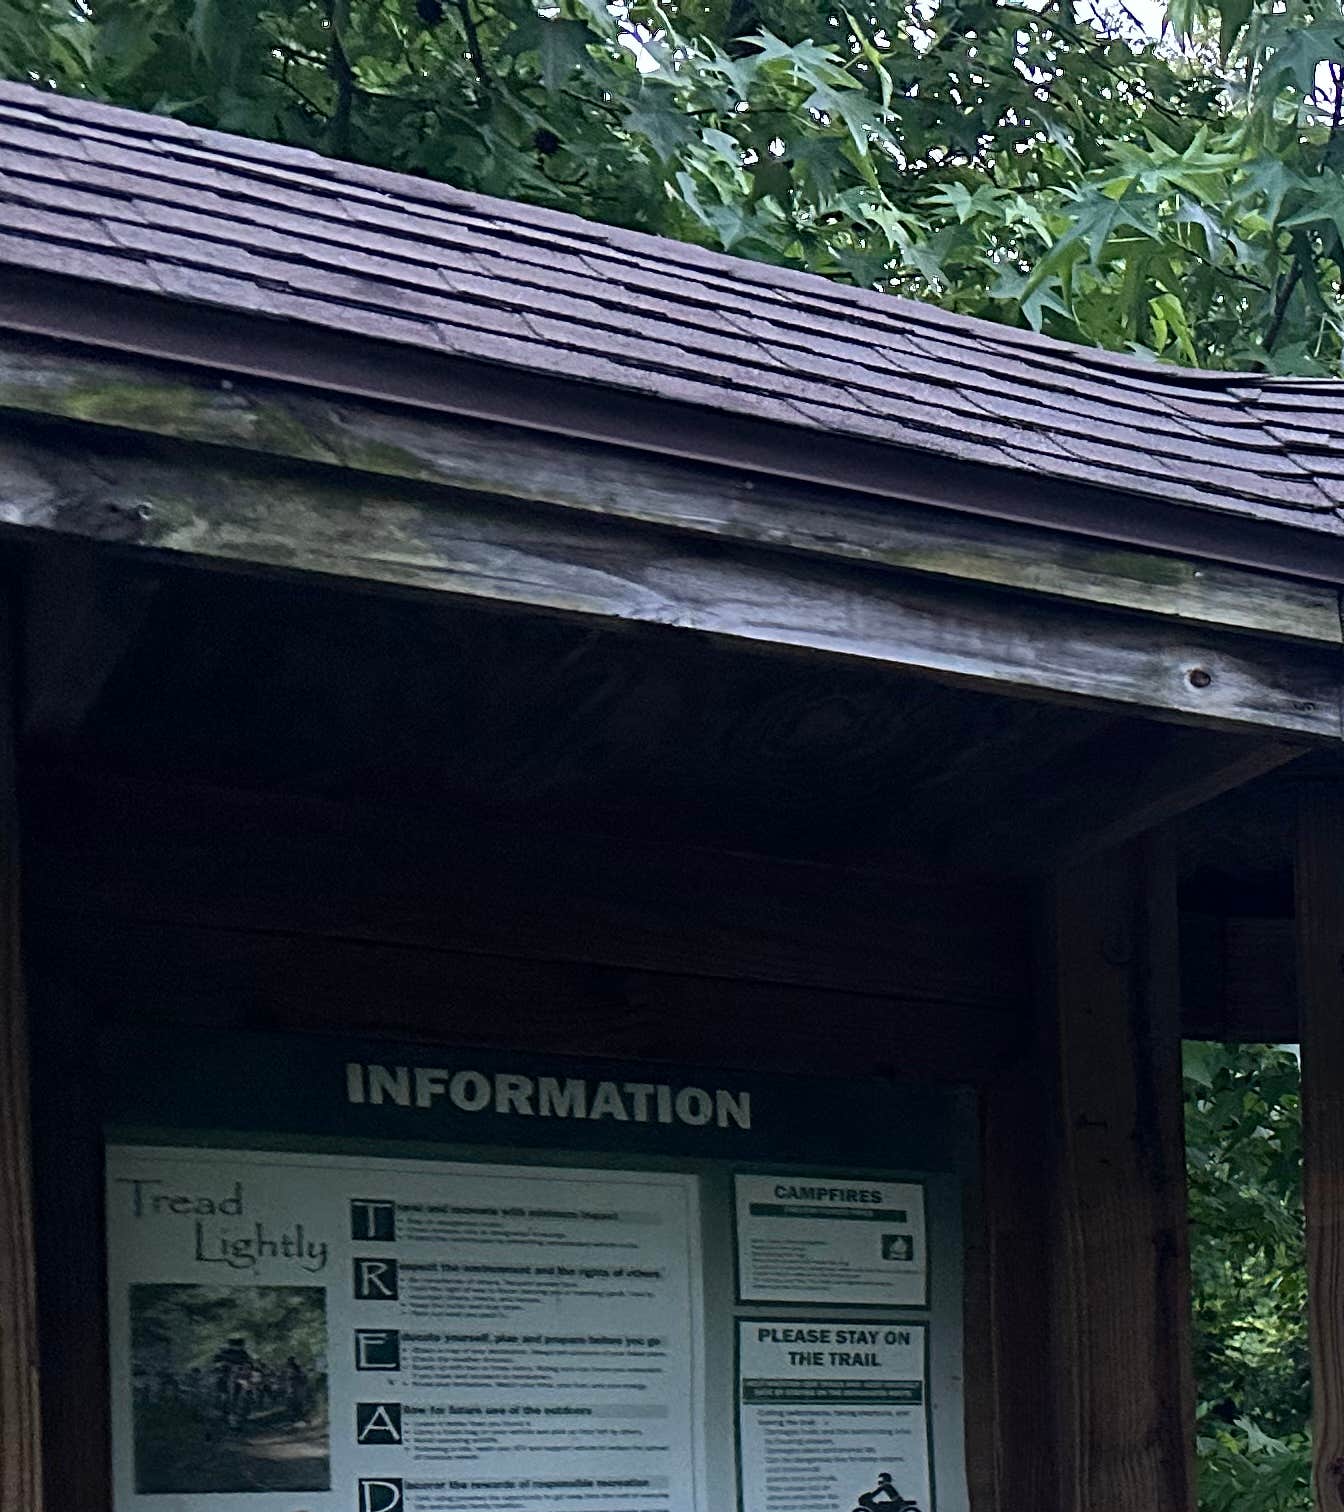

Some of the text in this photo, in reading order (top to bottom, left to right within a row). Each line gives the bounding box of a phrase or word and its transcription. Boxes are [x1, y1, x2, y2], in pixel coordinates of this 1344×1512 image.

[348, 1064, 751, 1130] INFORMATION
[116, 1179, 243, 1218] Tread
[773, 1184, 883, 1204] CAMPFIRES
[195, 1221, 329, 1276] Lightly
[758, 1328, 910, 1345] PLEASE STAY ON
[788, 1351, 881, 1367] THE TRAIL
